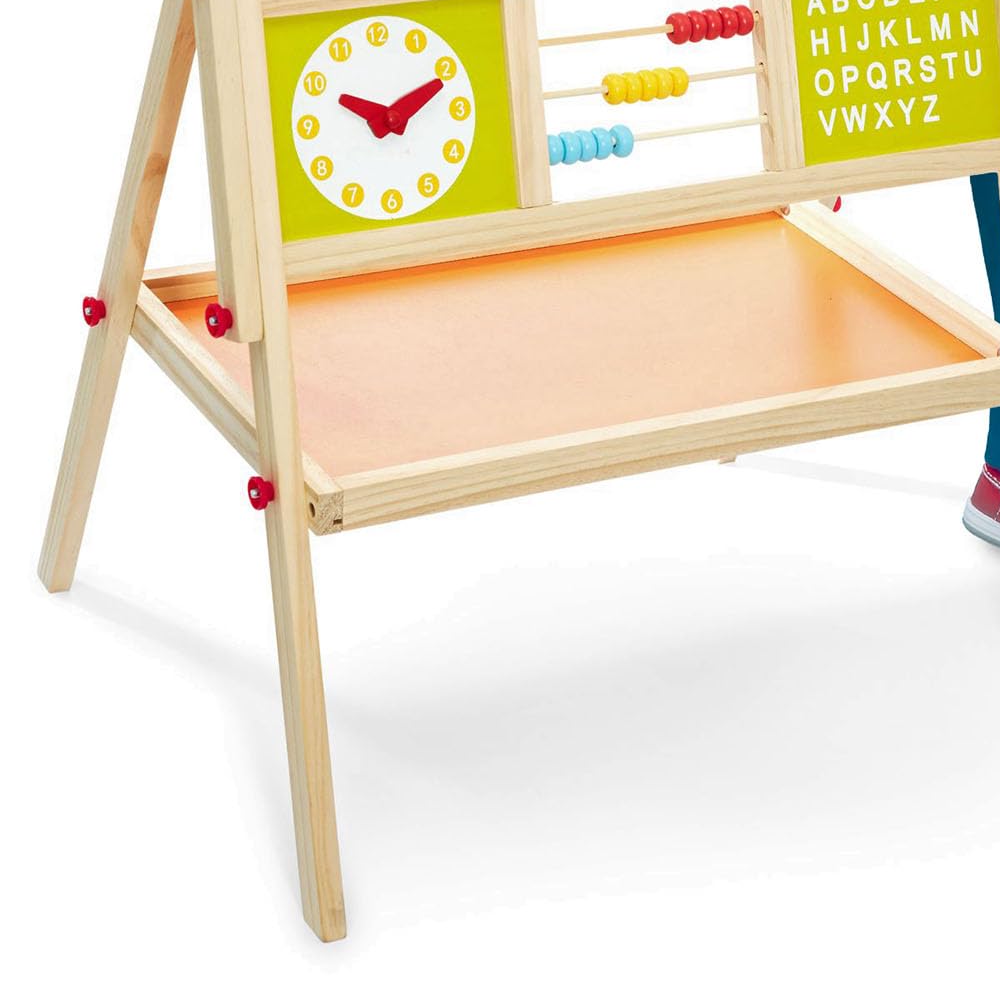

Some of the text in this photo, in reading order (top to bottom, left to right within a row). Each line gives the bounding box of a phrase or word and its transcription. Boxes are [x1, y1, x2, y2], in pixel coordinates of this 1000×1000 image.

[367, 26, 387, 43] 12
[810, 9, 979, 57] HIJKLMN
[412, 34, 420, 49] 1
[331, 42, 350, 58] 11
[441, 61, 451, 77] 2
[814, 48, 983, 97] OPQRSTU
[304, 75, 325, 92] 10
[455, 101, 465, 117] 3
[817, 94, 941, 137] VWXYZ
[302, 119, 313, 135] 9
[448, 144, 459, 159] 4
[317, 160, 328, 177] 8
[423, 177, 434, 193] 5
[347, 187, 358, 203] 7
[387, 194, 398, 210] 6
